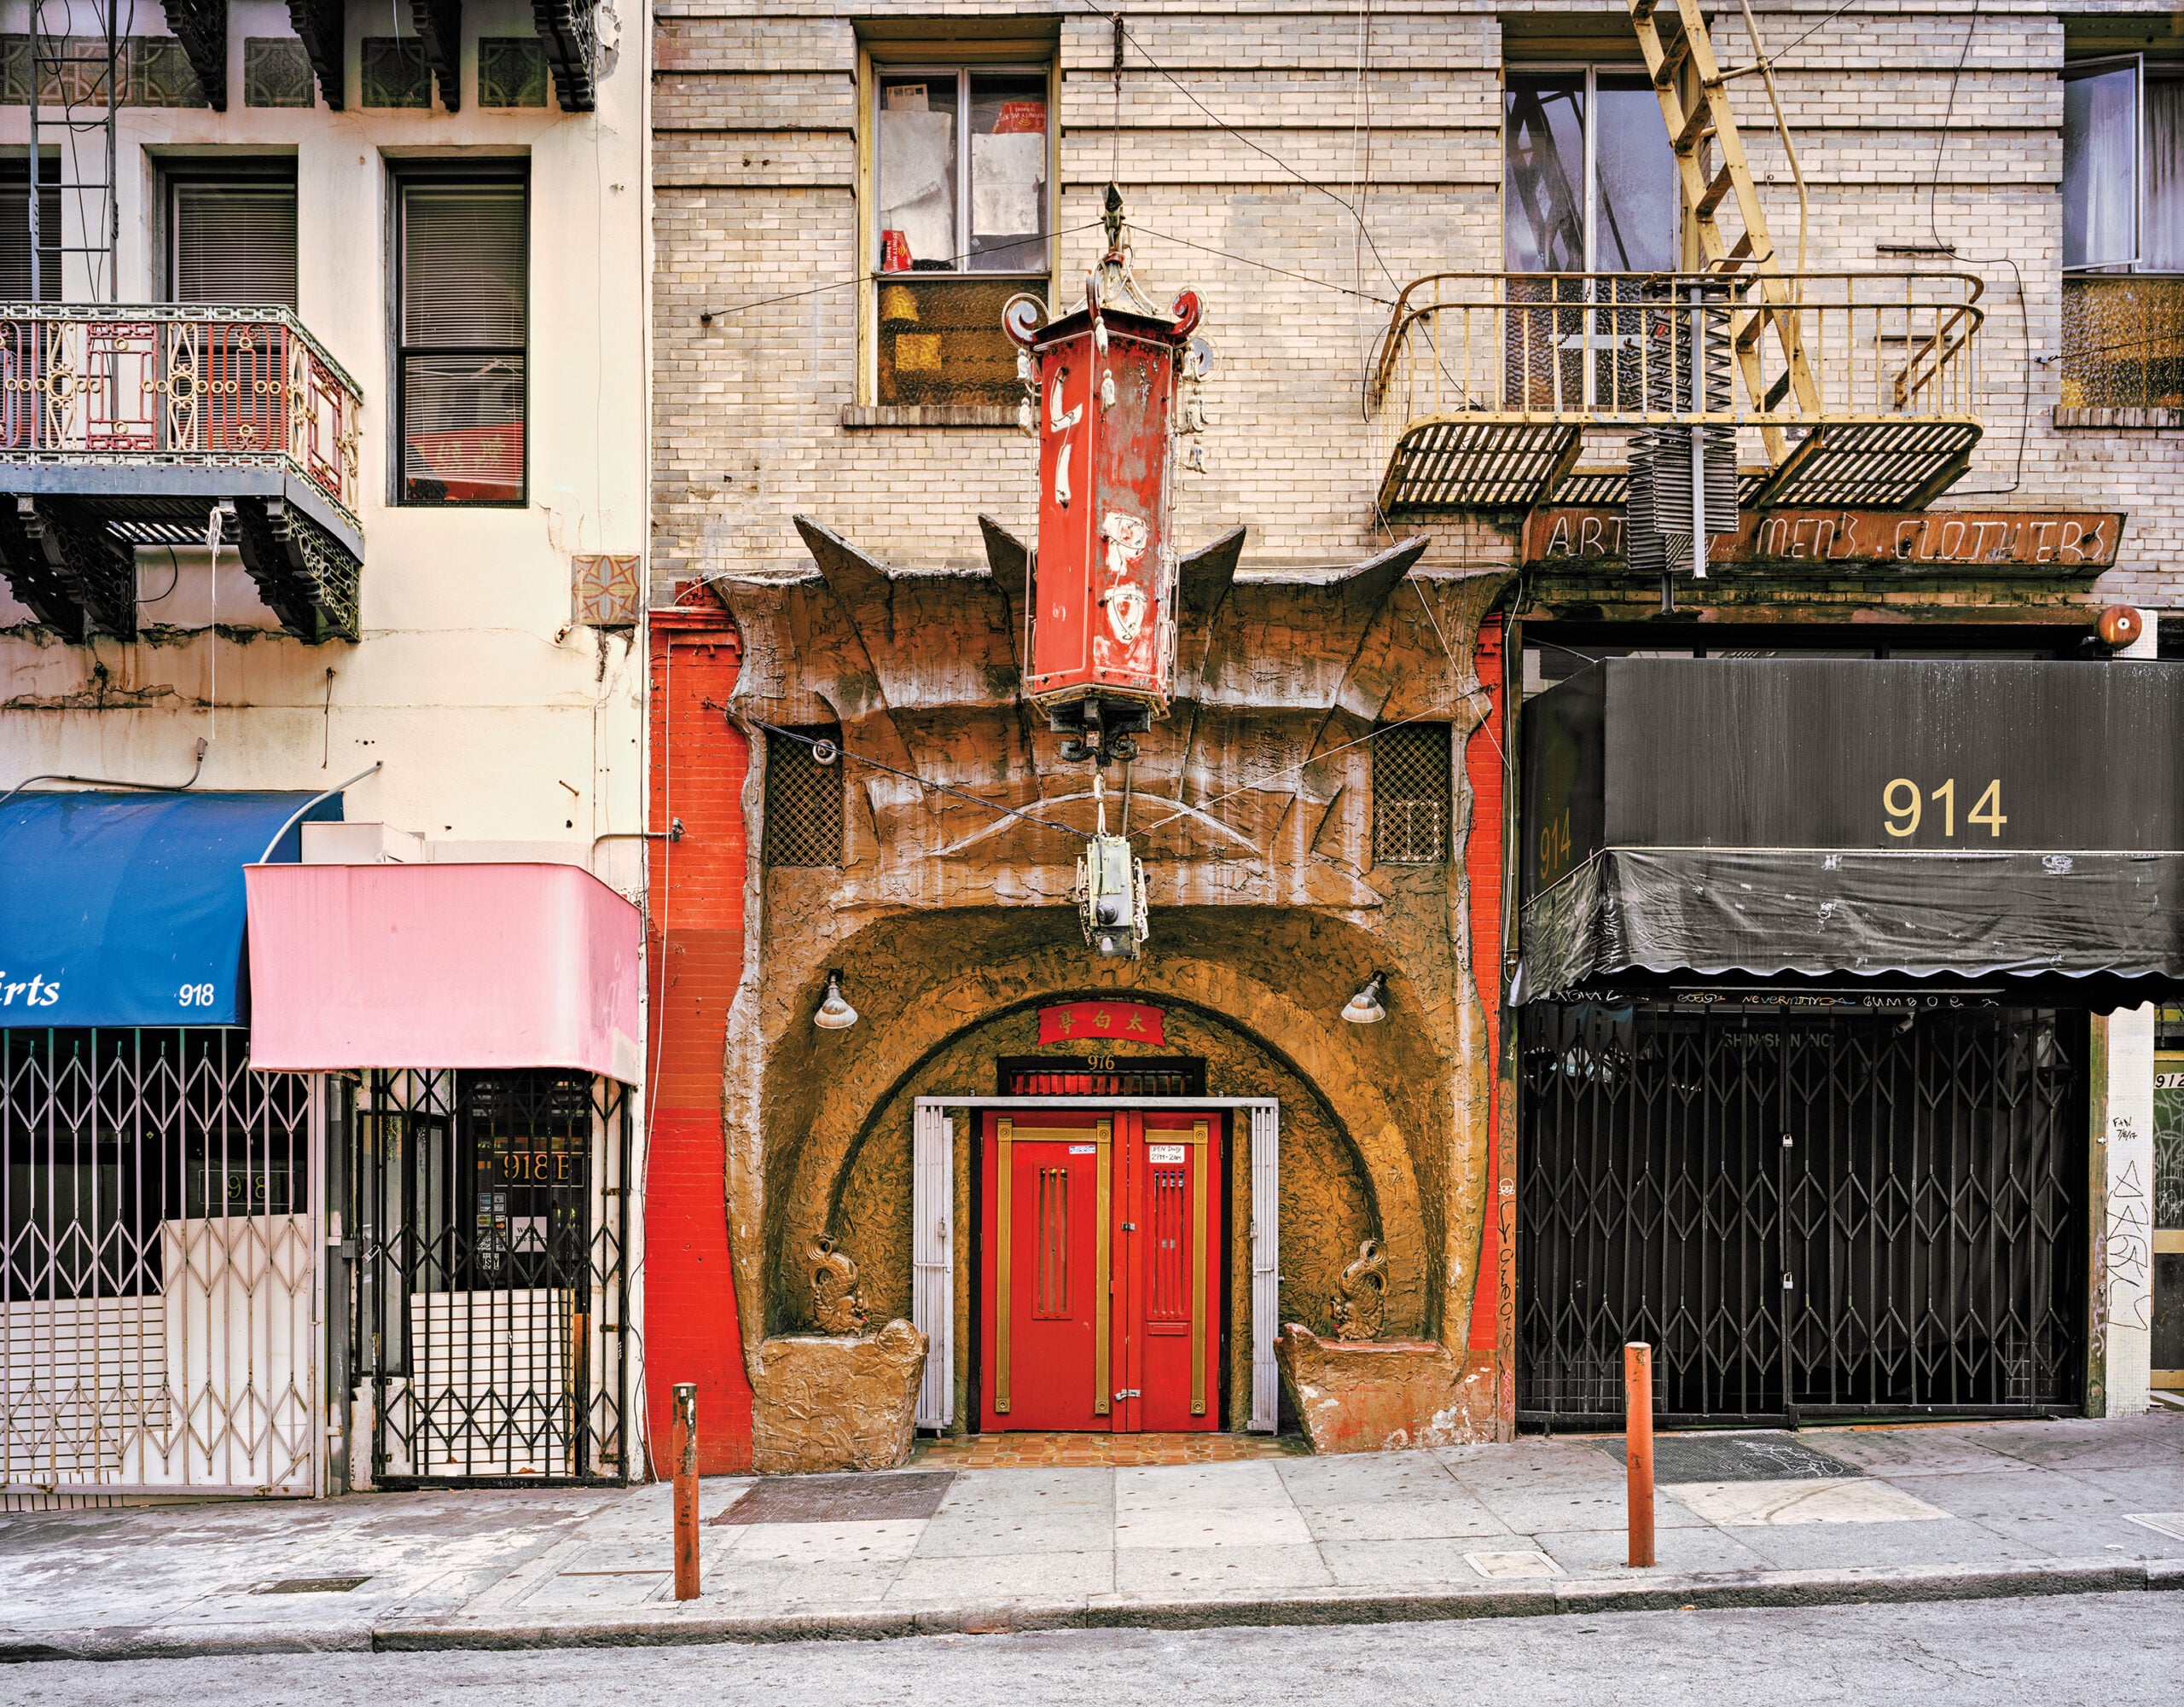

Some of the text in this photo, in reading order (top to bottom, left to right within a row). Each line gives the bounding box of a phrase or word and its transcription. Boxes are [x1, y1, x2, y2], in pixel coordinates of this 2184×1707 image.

[1883, 778, 2007, 837] 914
[1541, 807, 1571, 880] 914
[178, 983, 214, 1007] 918
[1724, 1033, 1759, 1048] SHN
[1764, 1033, 1801, 1048] SHN
[1088, 1055, 1115, 1071] 916
[2155, 1074, 2184, 1089] 912
[226, 1175, 267, 1199] 98
